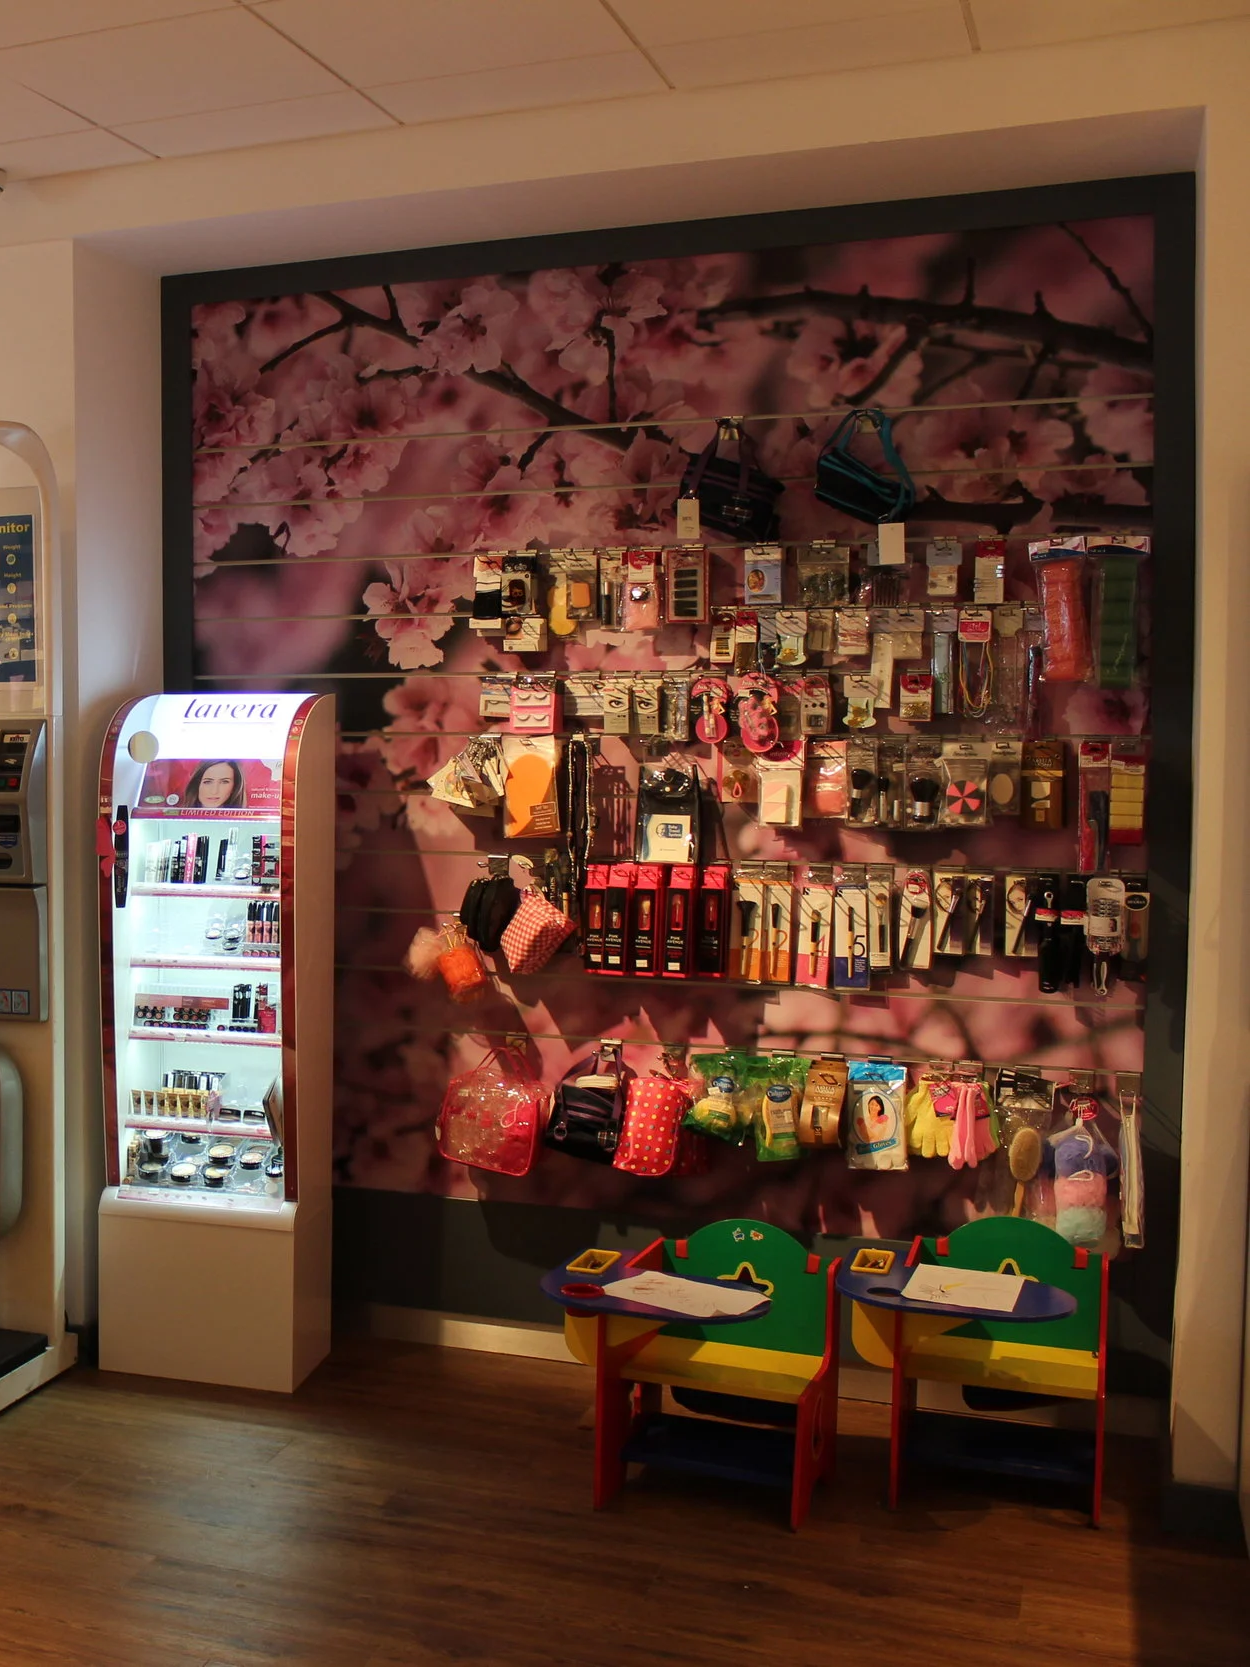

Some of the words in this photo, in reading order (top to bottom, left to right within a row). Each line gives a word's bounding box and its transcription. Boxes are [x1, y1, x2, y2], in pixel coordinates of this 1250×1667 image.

[183, 698, 278, 719] lavera
[816, 935, 827, 956] 4
[853, 935, 866, 957] 5
[872, 1140, 892, 1149] Gloves
